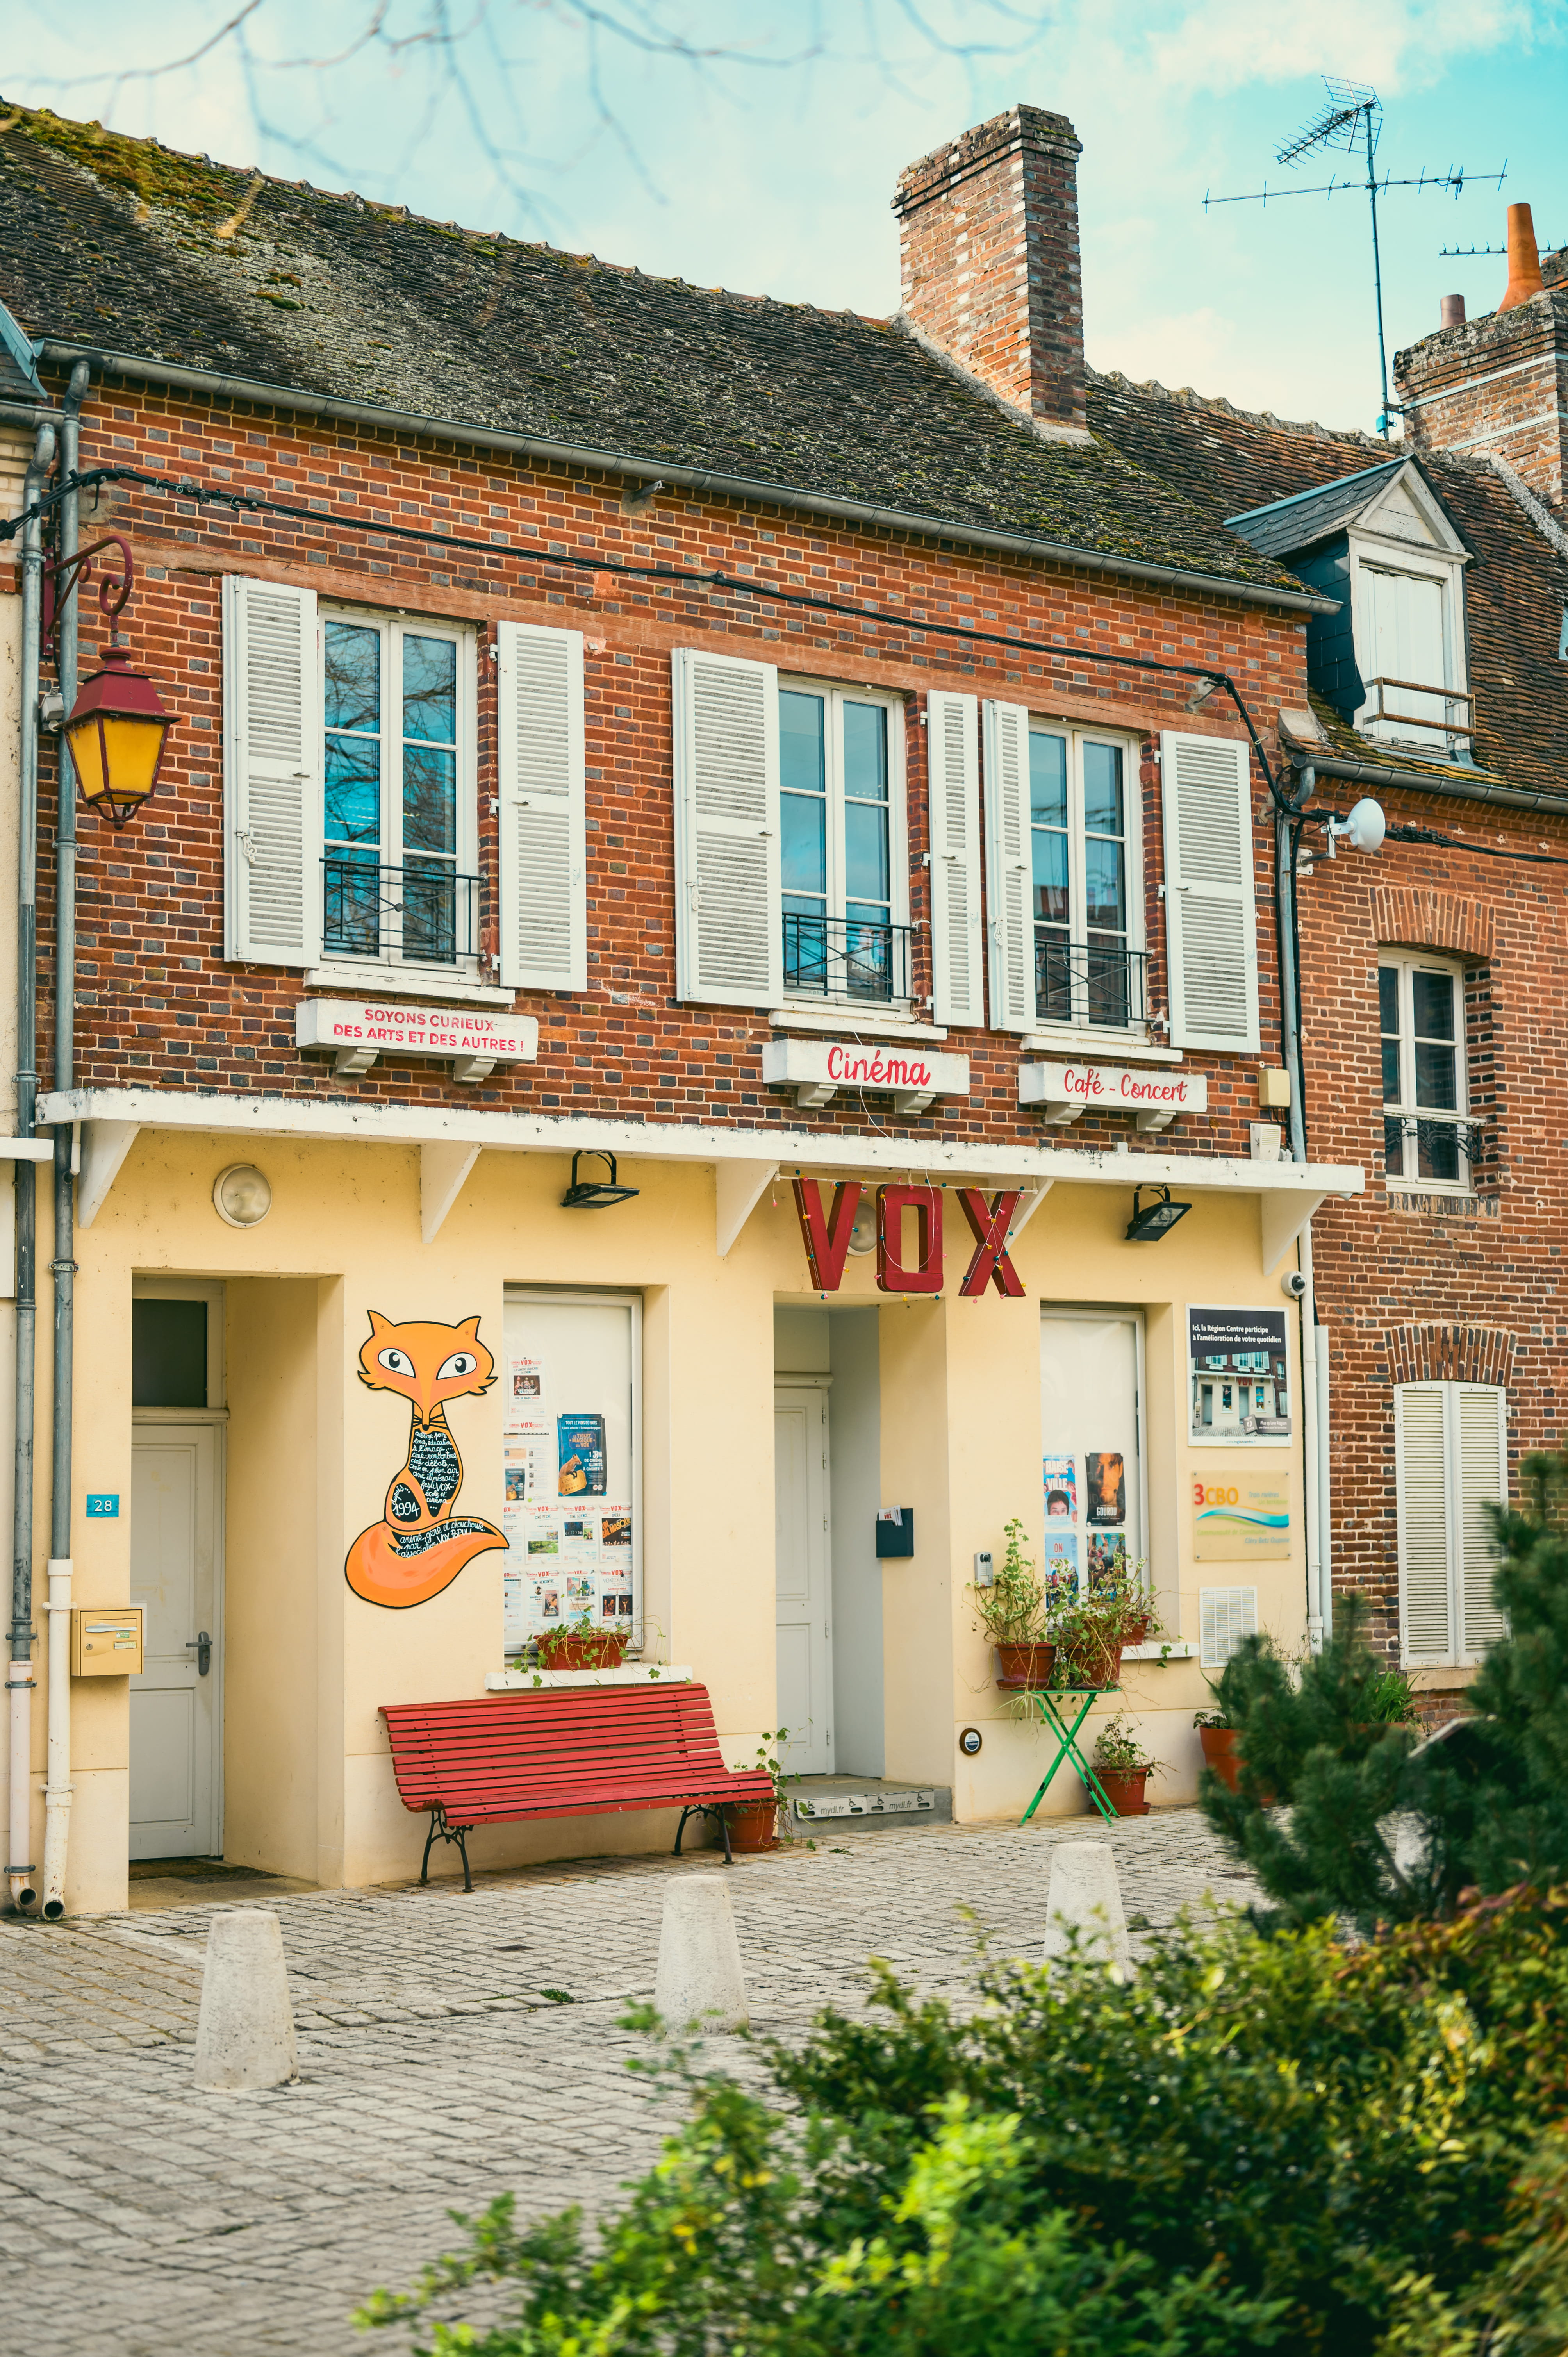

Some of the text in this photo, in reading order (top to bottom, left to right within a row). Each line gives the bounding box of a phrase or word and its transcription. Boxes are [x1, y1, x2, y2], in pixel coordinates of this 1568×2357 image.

[364, 1008, 495, 1032] SOYONS CURIEUX
[334, 1024, 524, 1052] DES ARTS ET DES AUTRES !
[827, 1046, 931, 1087] Cinéma
[1064, 1068, 1104, 1100] Café
[1120, 1073, 1188, 1103] Concert
[792, 1178, 1027, 1298] VOX
[1207, 1325, 1225, 1333] Région
[1245, 1326, 1268, 1335] participe
[1257, 1336, 1282, 1344] quotidien
[1237, 1377, 1252, 1386] VOX
[415, 1431, 447, 1440] culture pour
[413, 1438, 427, 1447] tous,
[1045, 1460, 1068, 1474] BAISE
[1046, 1478, 1068, 1492] VILLE
[1194, 1484, 1239, 1505] 3CBO
[94, 1499, 112, 1512] 28
[392, 1502, 420, 1517] 1994
[1097, 1507, 1117, 1516] GOUROU
[400, 1518, 485, 1543] animé, géré et chouchouté
[437, 1534, 450, 1544] VOX
[404, 1542, 421, 1553] par
[1054, 1543, 1063, 1552] ON
[821, 1806, 844, 1816] mydl.fr
[889, 1801, 912, 1811] mydl.fr
